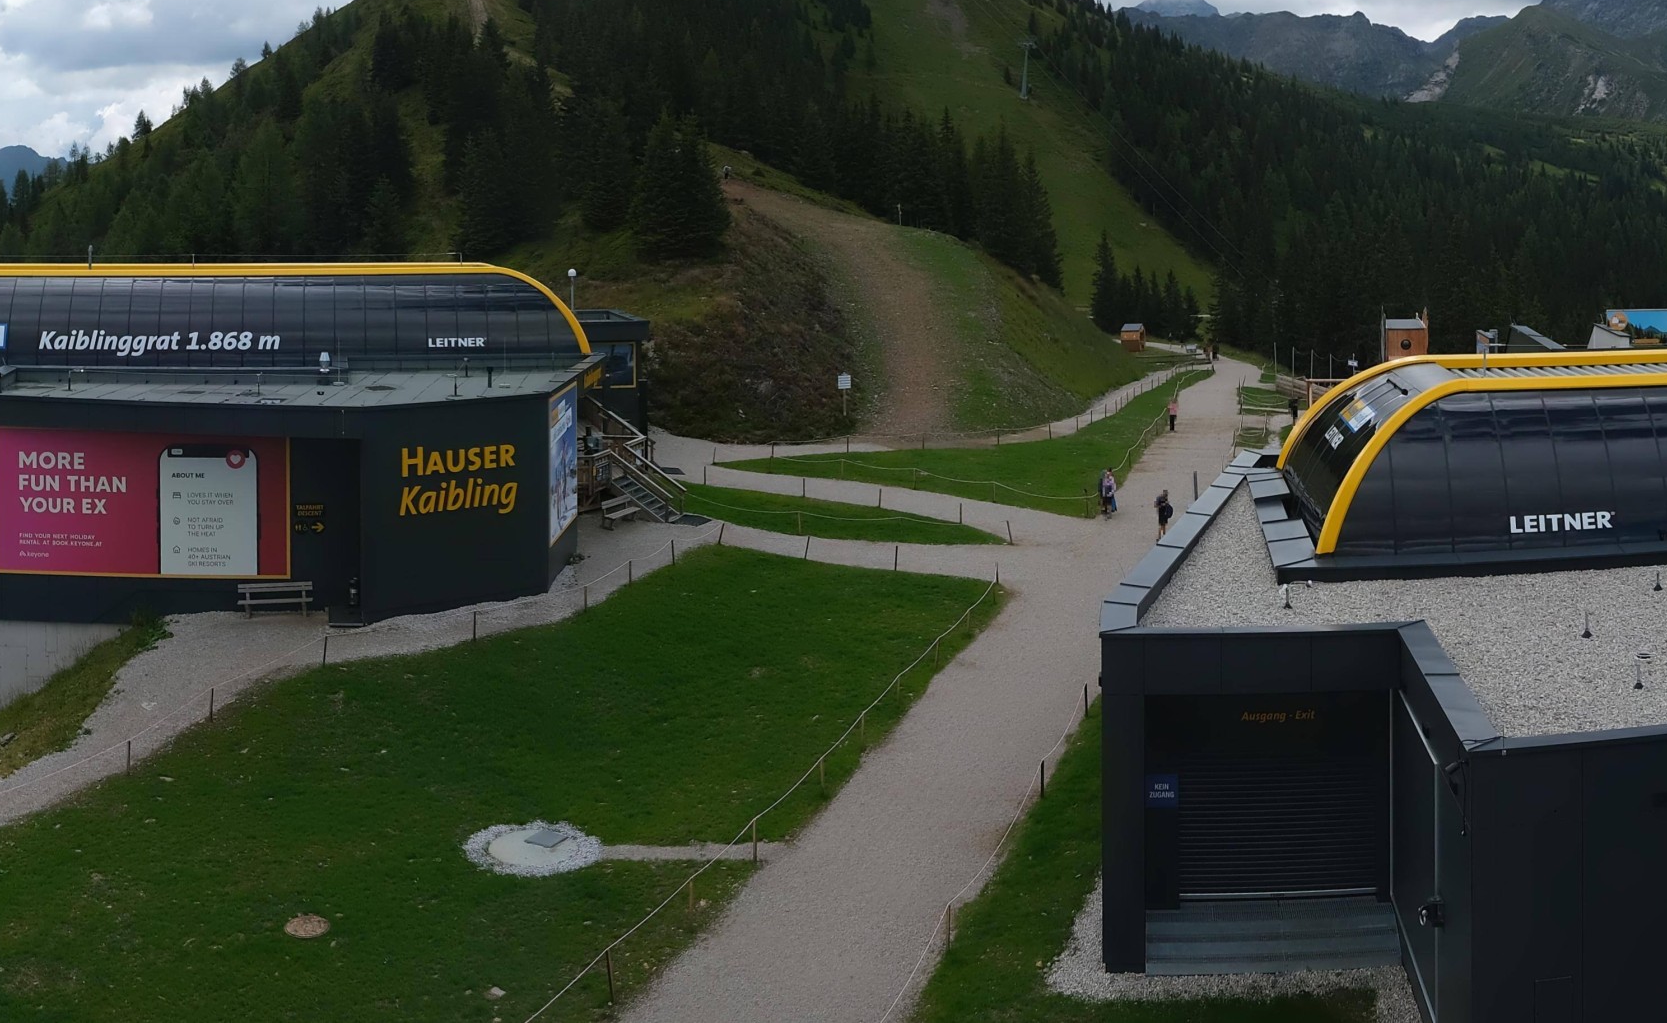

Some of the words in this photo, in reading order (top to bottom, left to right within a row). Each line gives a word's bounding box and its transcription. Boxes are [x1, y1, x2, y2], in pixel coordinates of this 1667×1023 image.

[38, 330, 180, 357] Kaiblinggrat
[186, 331, 252, 350] 1.868
[258, 335, 280, 350] m
[428, 337, 486, 347] LEITNER
[18, 451, 85, 470] MORE
[401, 444, 516, 477] HAUSER
[18, 474, 60, 491] FUN
[67, 476, 127, 493] THAN
[20, 497, 75, 513] YOUR
[82, 498, 107, 514] EX
[400, 477, 518, 516] Kaibling
[1510, 511, 1612, 533] LEITNER
[1241, 711, 1286, 723] Ausgang
[1295, 709, 1315, 720] Exit
